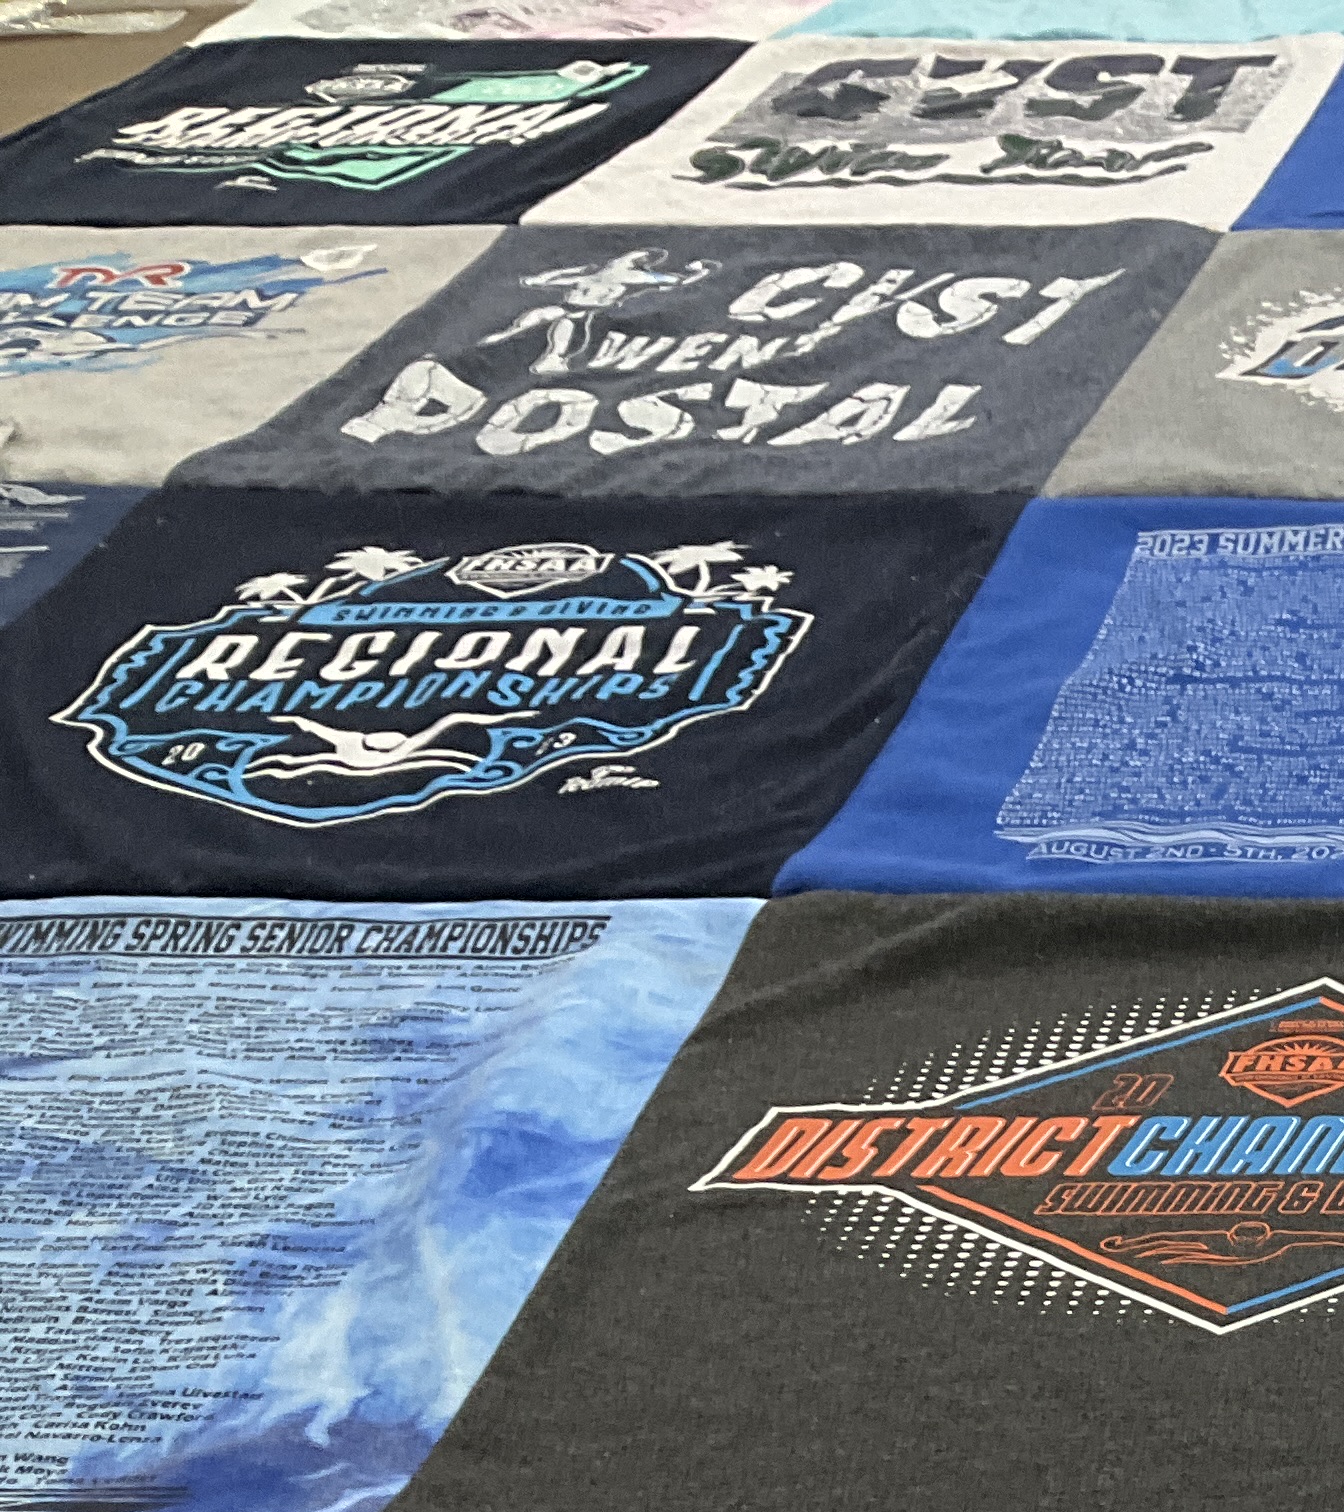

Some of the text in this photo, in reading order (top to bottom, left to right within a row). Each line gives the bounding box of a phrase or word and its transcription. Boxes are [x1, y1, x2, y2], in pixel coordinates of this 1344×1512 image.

[84, 289, 302, 312] TEAM
[589, 322, 842, 371] WENT
[341, 355, 981, 456] POSTAL
[1135, 534, 1209, 556] 2023
[177, 626, 700, 681] REGIONAL
[156, 673, 678, 713] CHAMPIONSHIPS
[1028, 841, 1142, 861] AUGUST
[1147, 845, 1202, 861] 2ND
[125, 918, 241, 955] SPRING
[241, 922, 352, 955] SENIOR
[353, 921, 606, 956] CHAMPIONSHIPS
[1093, 1073, 1174, 1111] 20
[730, 1114, 1141, 1182] DISTRICT
[1033, 1181, 1286, 1217] SWIMMING
